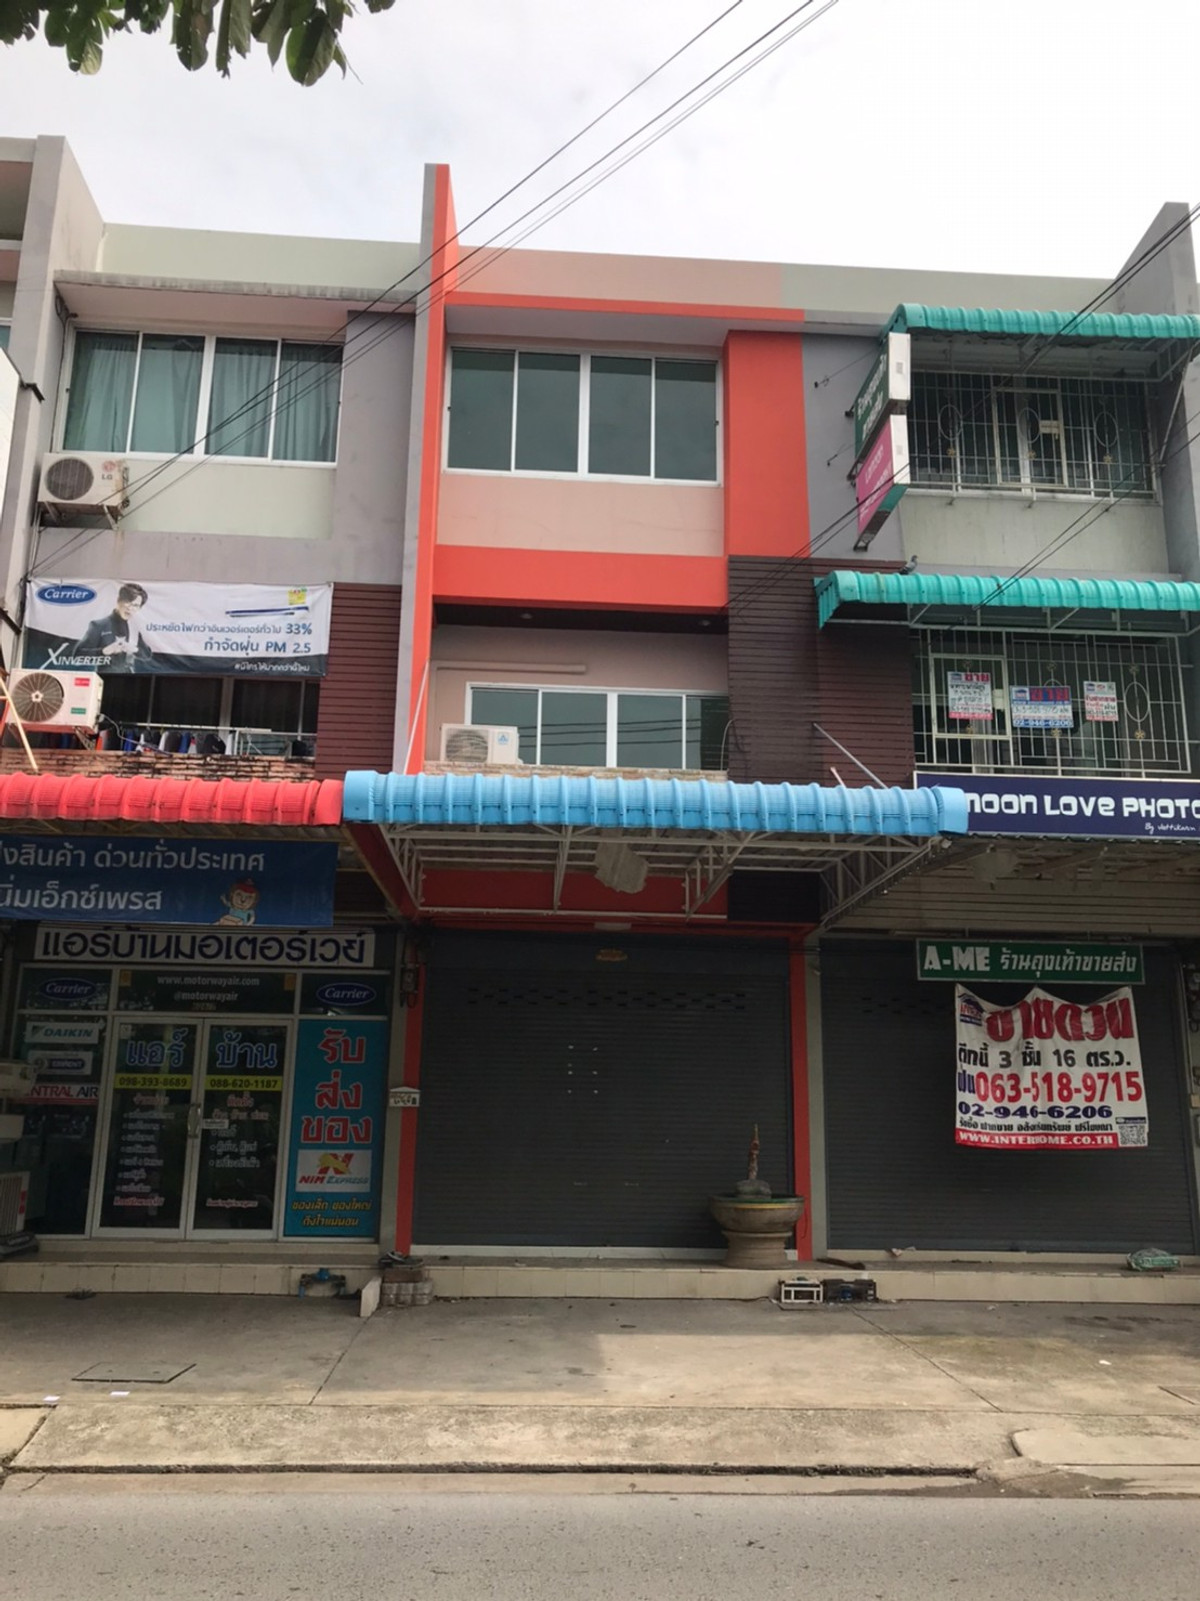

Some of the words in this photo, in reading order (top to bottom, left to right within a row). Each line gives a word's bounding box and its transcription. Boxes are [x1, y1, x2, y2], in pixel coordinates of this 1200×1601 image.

[44, 588, 89, 599] Carrier
[285, 623, 312, 635] 33%
[204, 635, 260, 656] กำจัดฝุ่น
[265, 641, 287, 653] PM
[293, 642, 312, 653] 2.5
[1145, 822, 1155, 835] By
[0, 842, 86, 868] งสินค้า
[94, 839, 264, 872] ด่วนทั่วประเทศ
[924, 945, 990, 972] A-ME
[1000, 948, 1137, 978] ร้านถุงเท้าขายส่ง
[45, 983, 93, 996] Carrier
[157, 976, 260, 987] www.motorwayair.com
[324, 987, 369, 999] Carrier
[44, 1028, 93, 1037] DAIKIN
[126, 1027, 188, 1067] แอร์
[215, 1031, 278, 1068] บ้าน
[319, 1028, 366, 1064] รับ
[999, 1051, 1012, 1068] 3
[1053, 1050, 1076, 1066] 16
[1086, 1050, 1132, 1067] ตร.ว.
[77, 1086, 99, 1097] AIR
[316, 1070, 362, 1109] ส่ง
[301, 1116, 373, 1143] ของ
